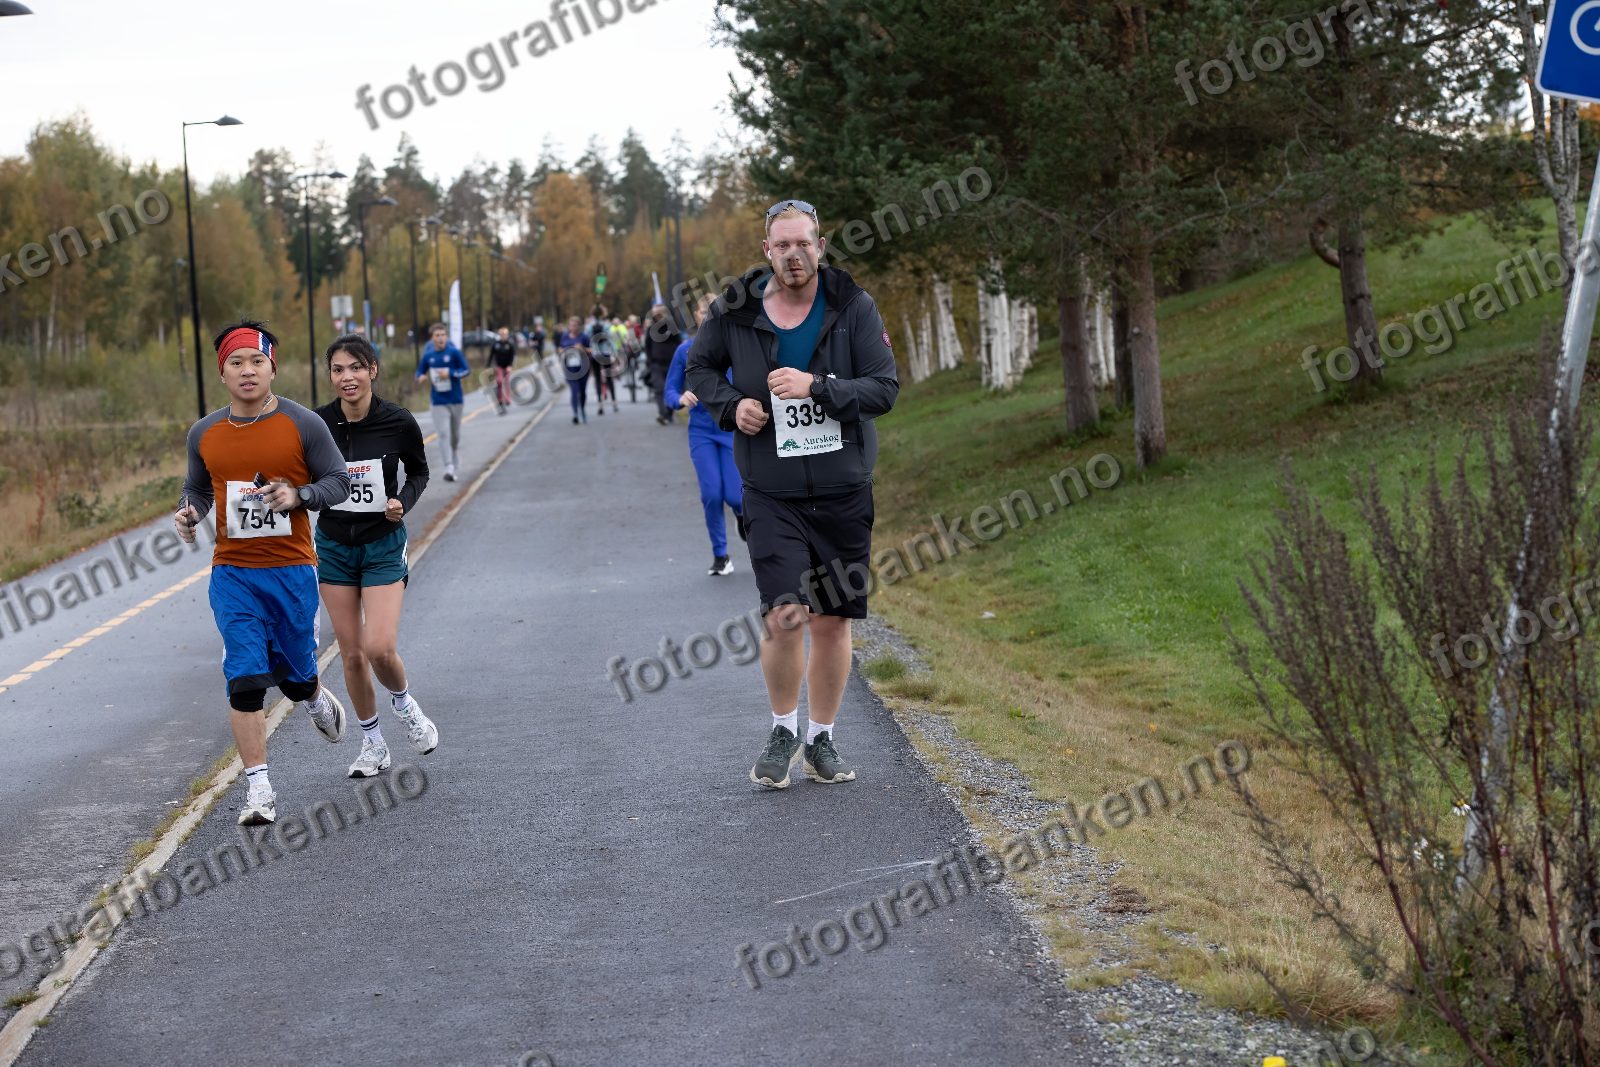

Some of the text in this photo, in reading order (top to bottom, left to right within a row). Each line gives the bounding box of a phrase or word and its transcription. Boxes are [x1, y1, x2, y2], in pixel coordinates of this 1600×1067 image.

[785, 403, 826, 429] 339
[803, 434, 839, 446] Aurskog
[348, 465, 371, 473] RGES
[348, 472, 366, 480] PET
[241, 494, 264, 502] LØPE
[350, 483, 374, 504] 55
[237, 507, 277, 530] 754
